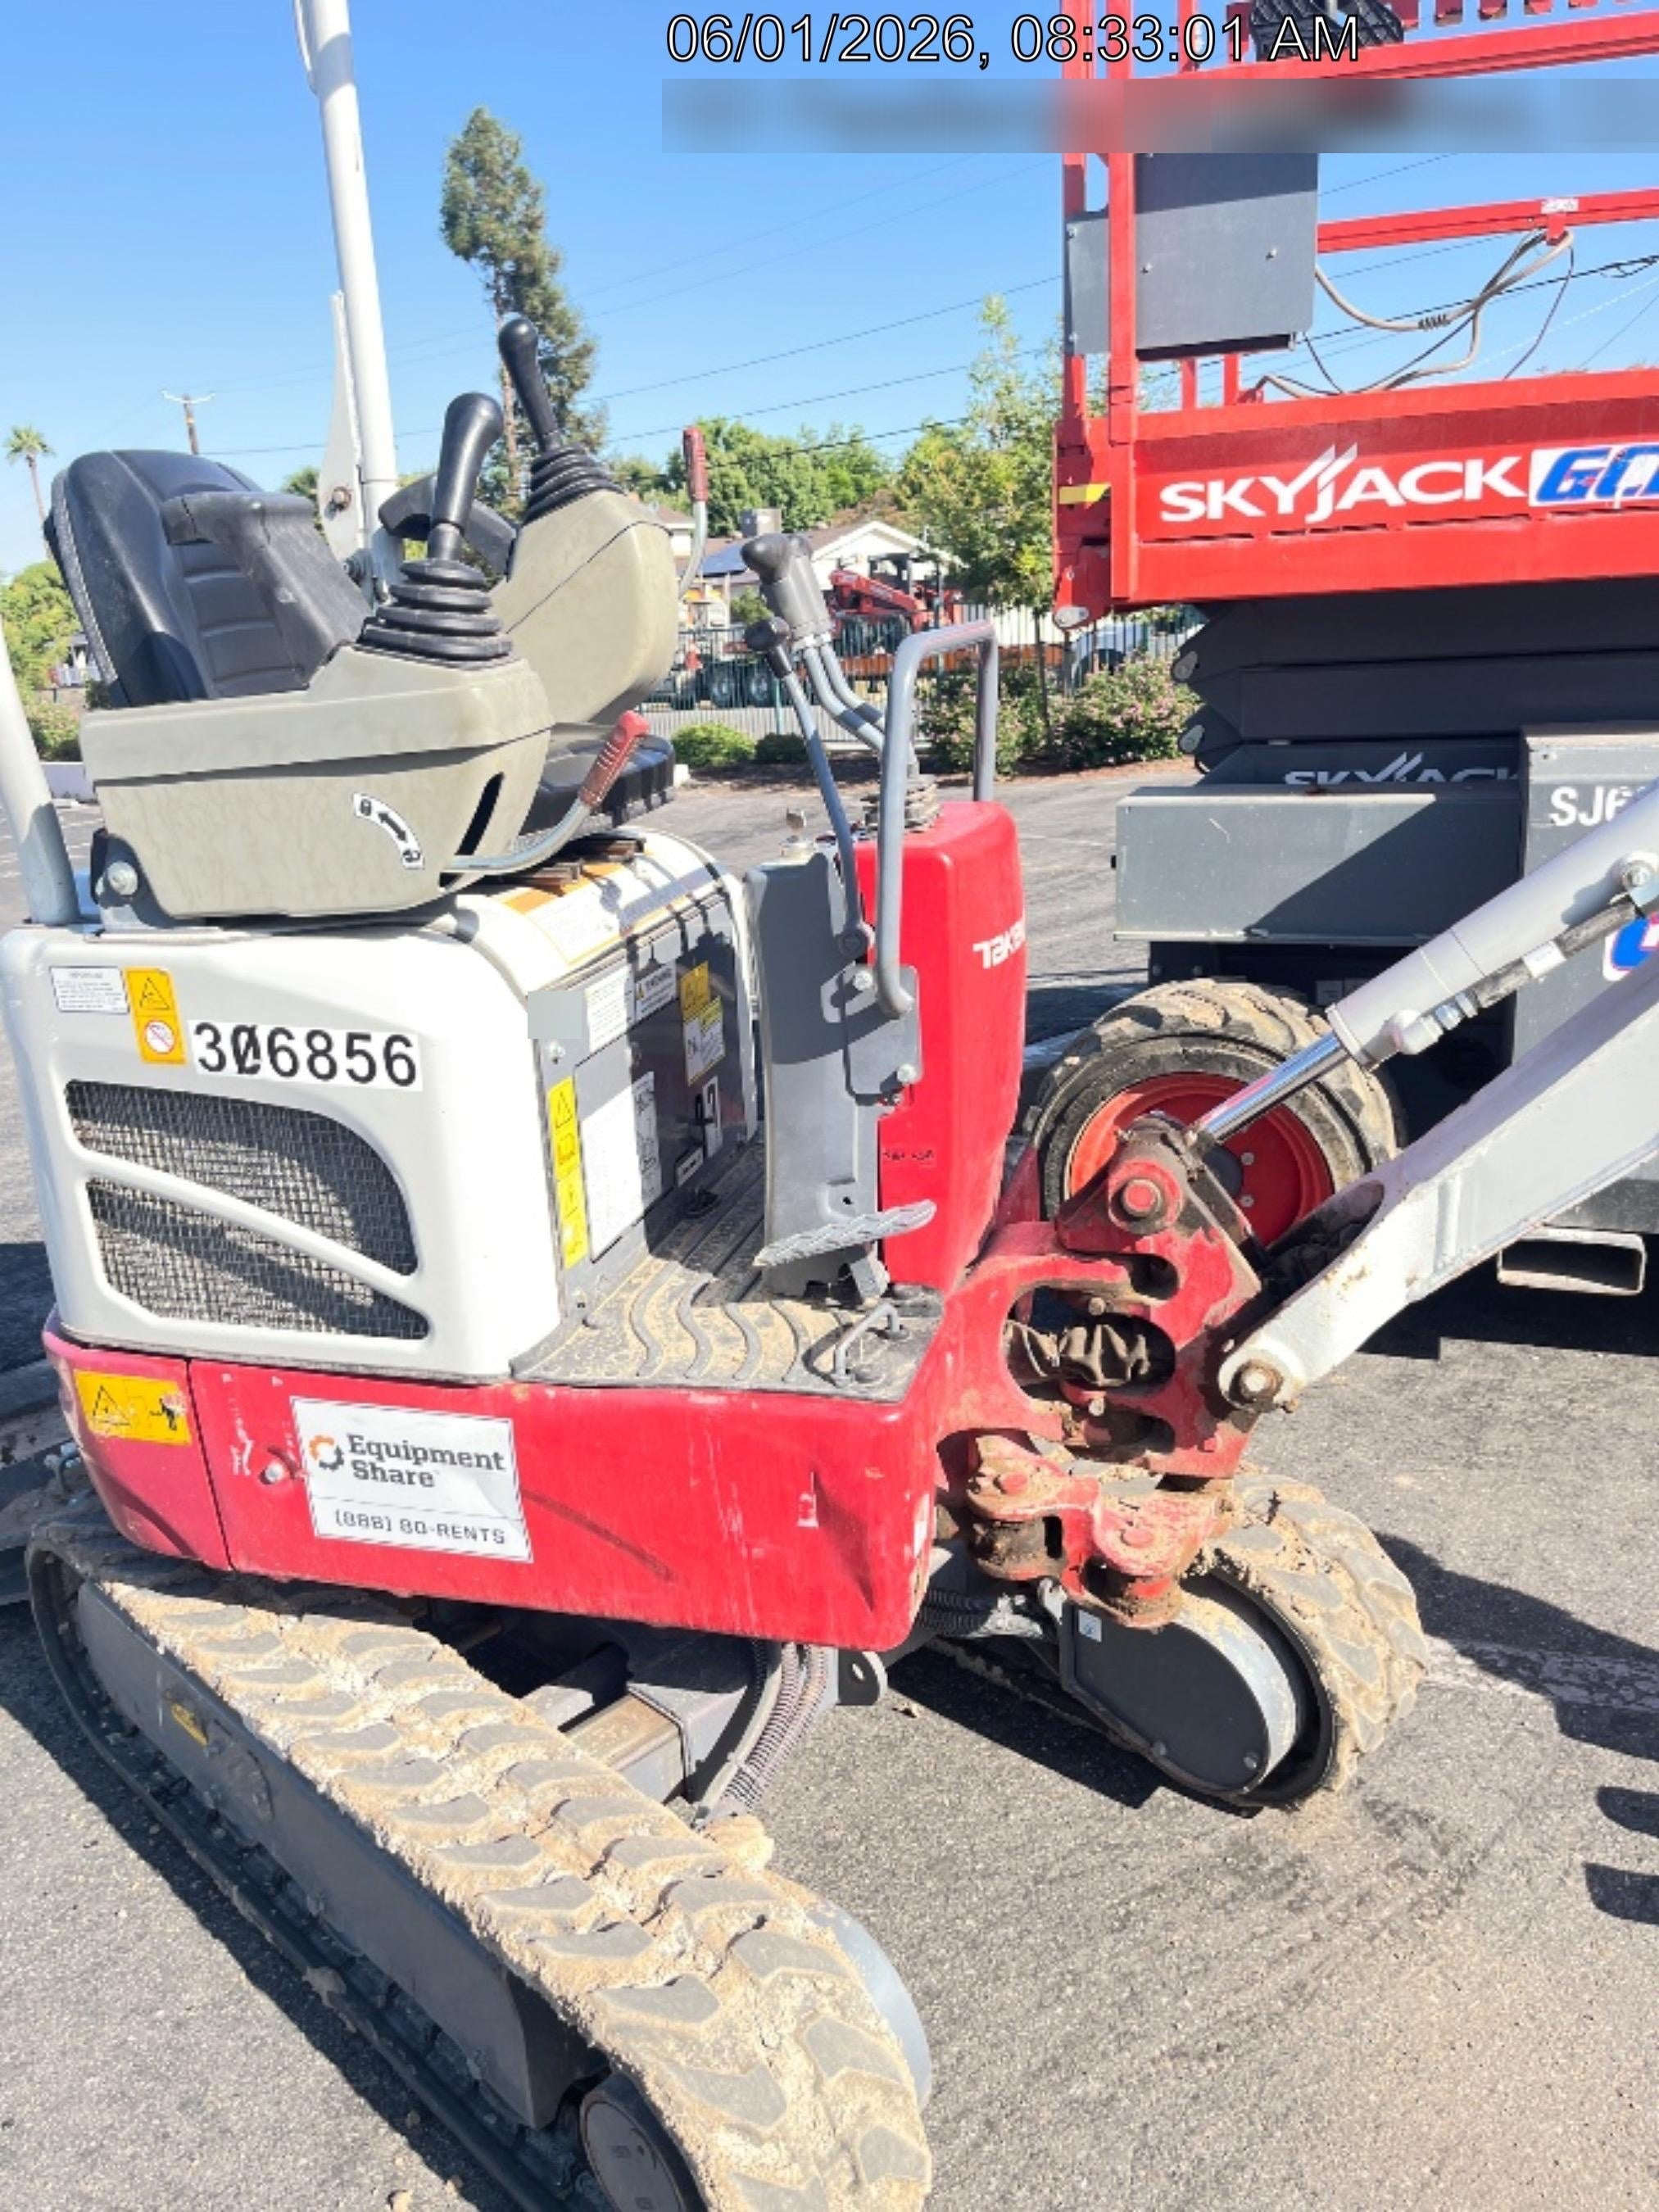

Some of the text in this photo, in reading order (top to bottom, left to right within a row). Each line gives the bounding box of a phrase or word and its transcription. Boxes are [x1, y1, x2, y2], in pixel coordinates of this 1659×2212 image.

[1160, 442, 1528, 524] SKYJACK
[347, 1434, 506, 1471] Equipment
[351, 1460, 435, 1488] Share
